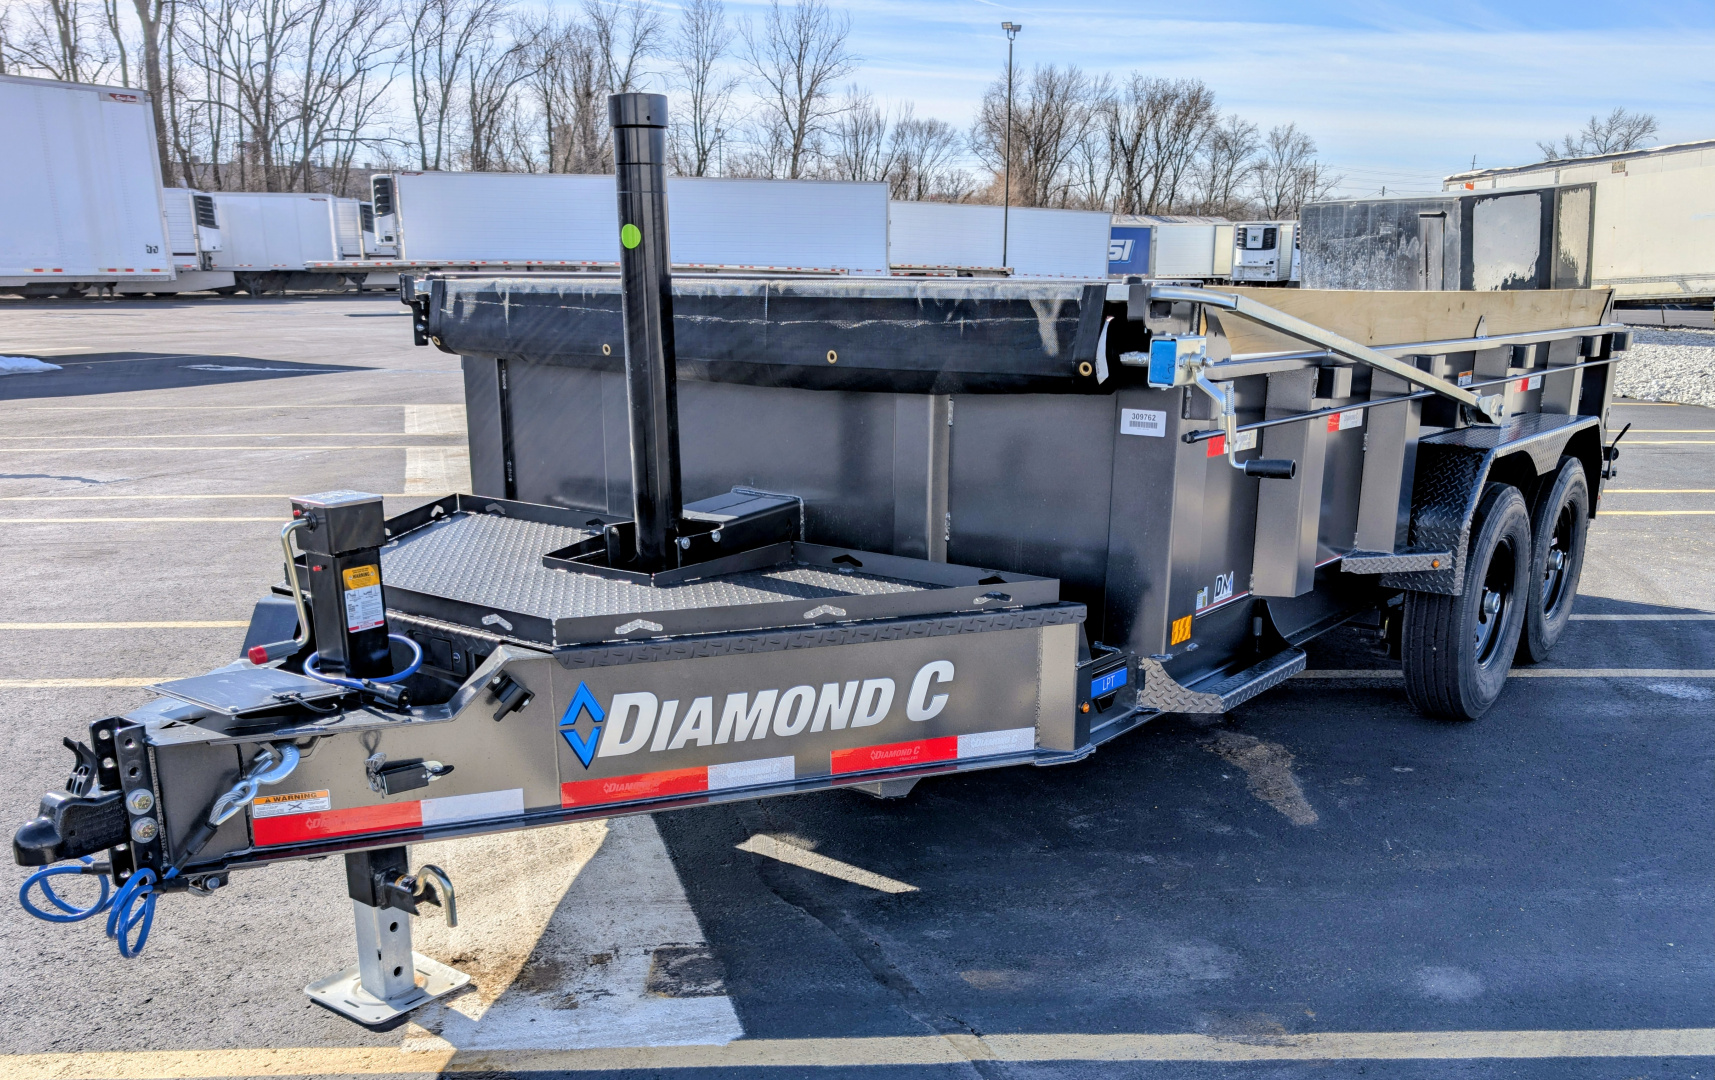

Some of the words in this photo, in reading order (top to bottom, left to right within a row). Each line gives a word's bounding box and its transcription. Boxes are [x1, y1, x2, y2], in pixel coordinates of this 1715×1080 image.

[1131, 413, 1157, 421] 309762
[1103, 675, 1115, 690] LPT
[597, 677, 896, 758] DIAMOND
[906, 660, 955, 722] C
[875, 749, 912, 760] DIAMOND
[913, 746, 920, 755] C
[273, 792, 317, 802] WARNING
